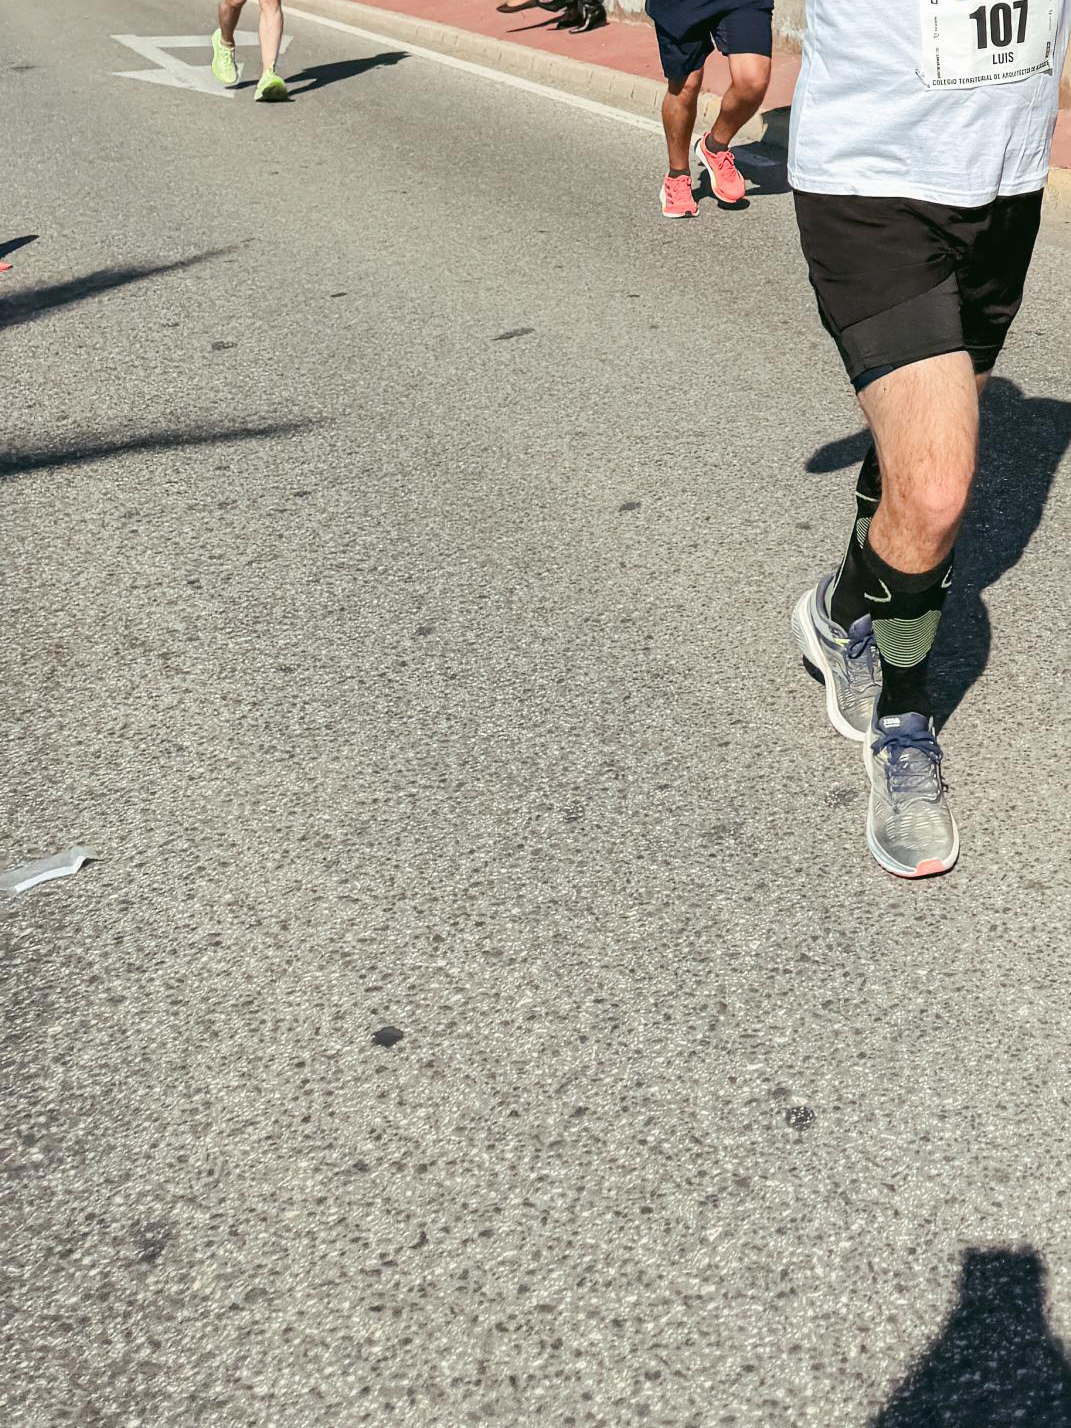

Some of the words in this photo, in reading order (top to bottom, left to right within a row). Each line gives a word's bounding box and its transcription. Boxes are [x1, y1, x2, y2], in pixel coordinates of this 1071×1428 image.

[969, 0, 1029, 50] 107
[992, 52, 1014, 65] LUIS
[932, 78, 957, 86] COLEGIO
